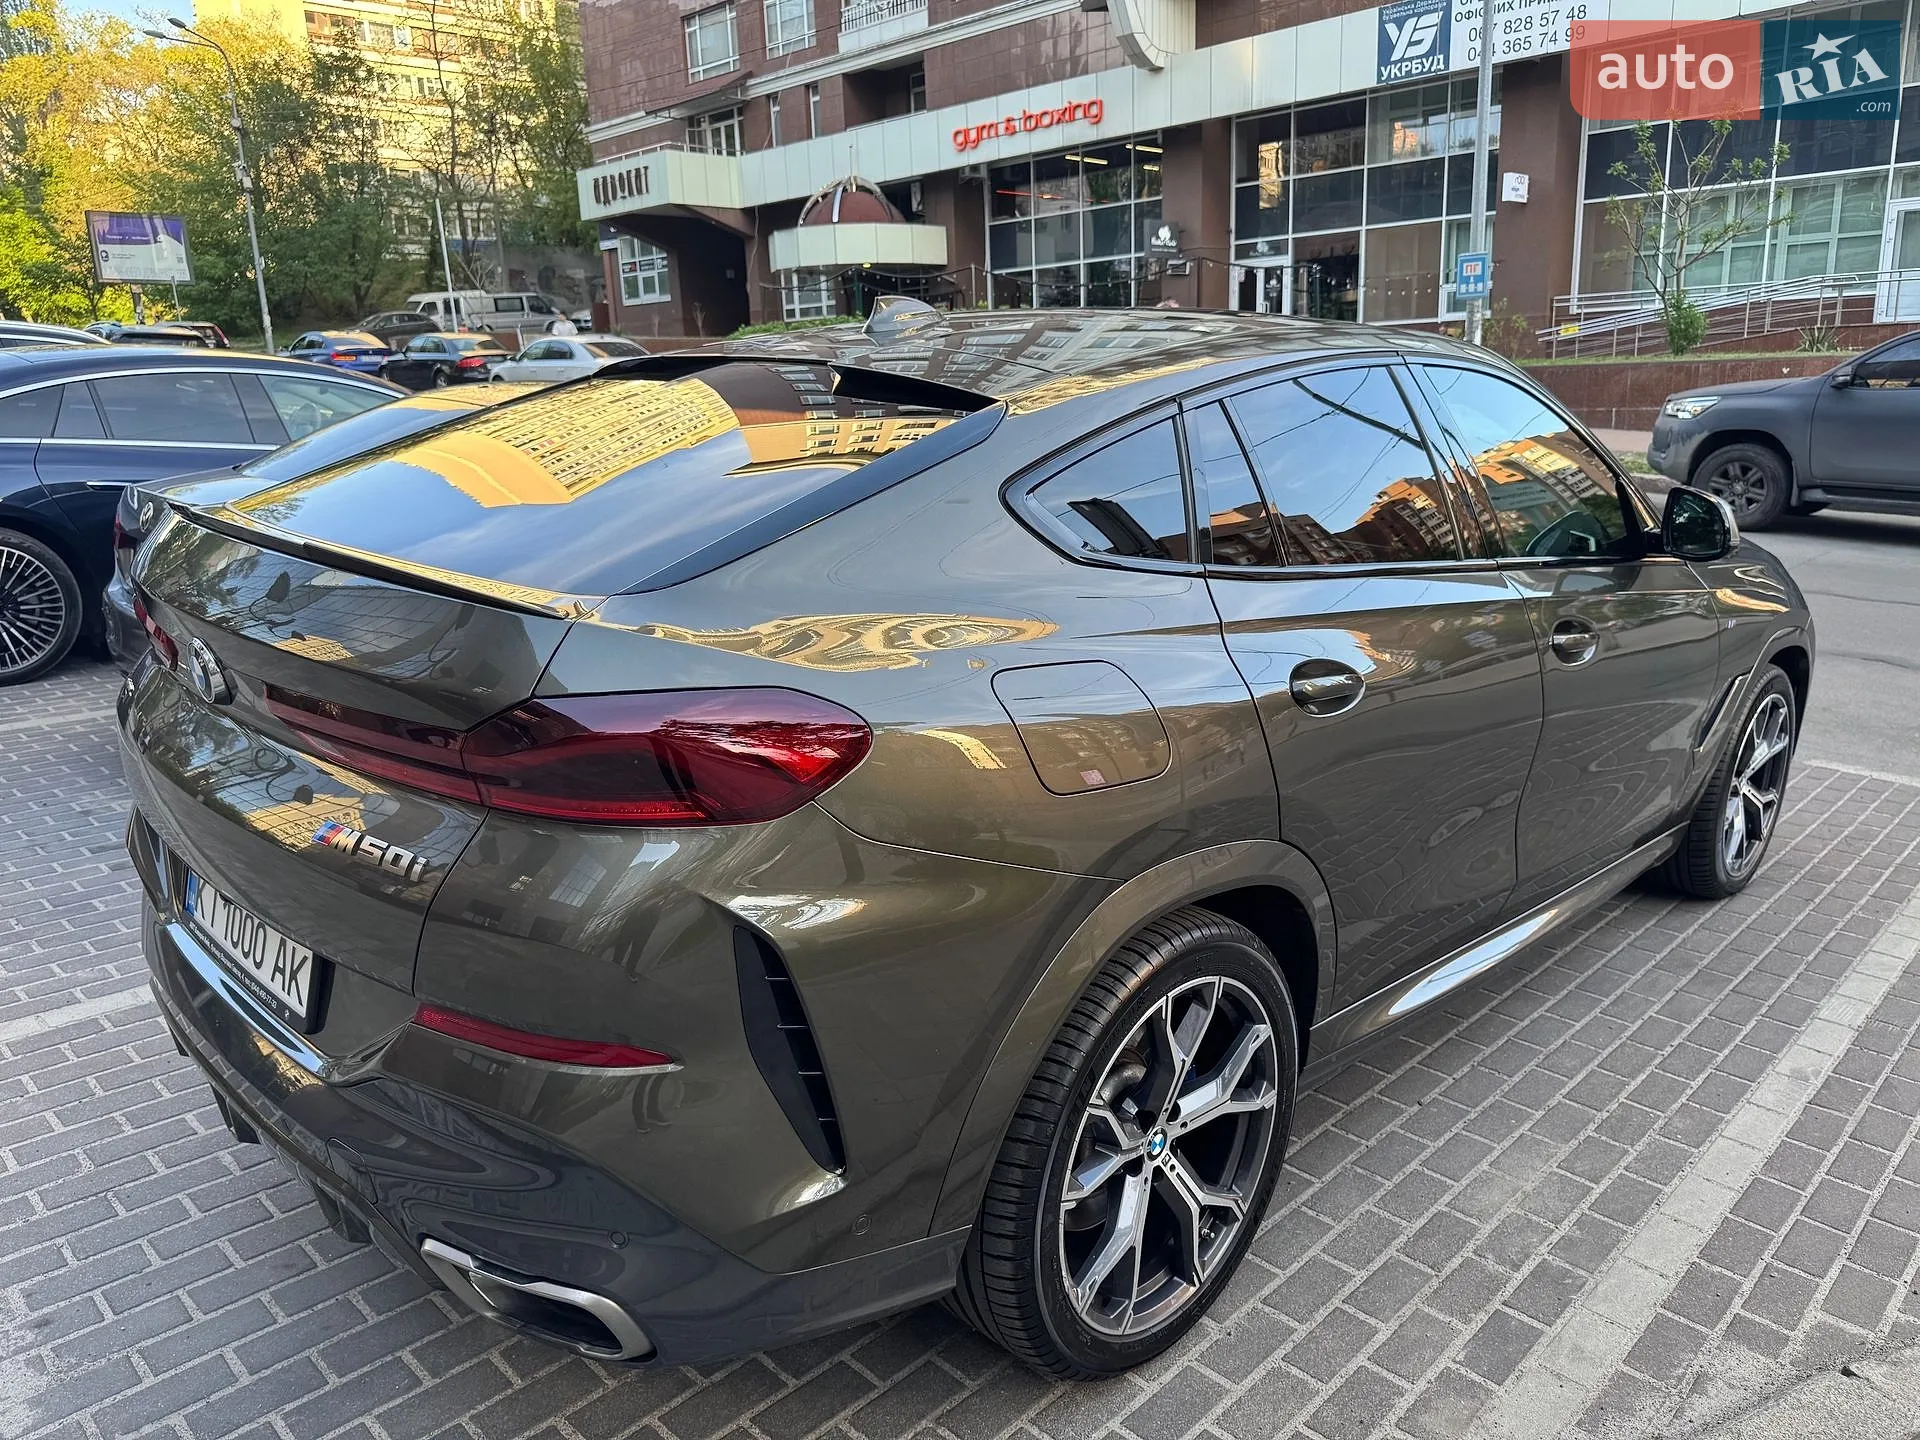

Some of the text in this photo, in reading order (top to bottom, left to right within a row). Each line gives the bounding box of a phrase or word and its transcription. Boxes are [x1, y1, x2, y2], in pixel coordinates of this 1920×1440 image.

[1503, 16, 1533, 34] 828
[1539, 10, 1560, 27] 57
[1566, 4, 1587, 21] 48
[1502, 35, 1532, 54] 365
[1538, 30, 1558, 48] 74
[1564, 25, 1585, 42] 99
[1381, 54, 1445, 80] УКРБУД
[952, 98, 1104, 152] gym & boxing
[222, 899, 268, 970] 1000
[270, 936, 309, 1008] AK
